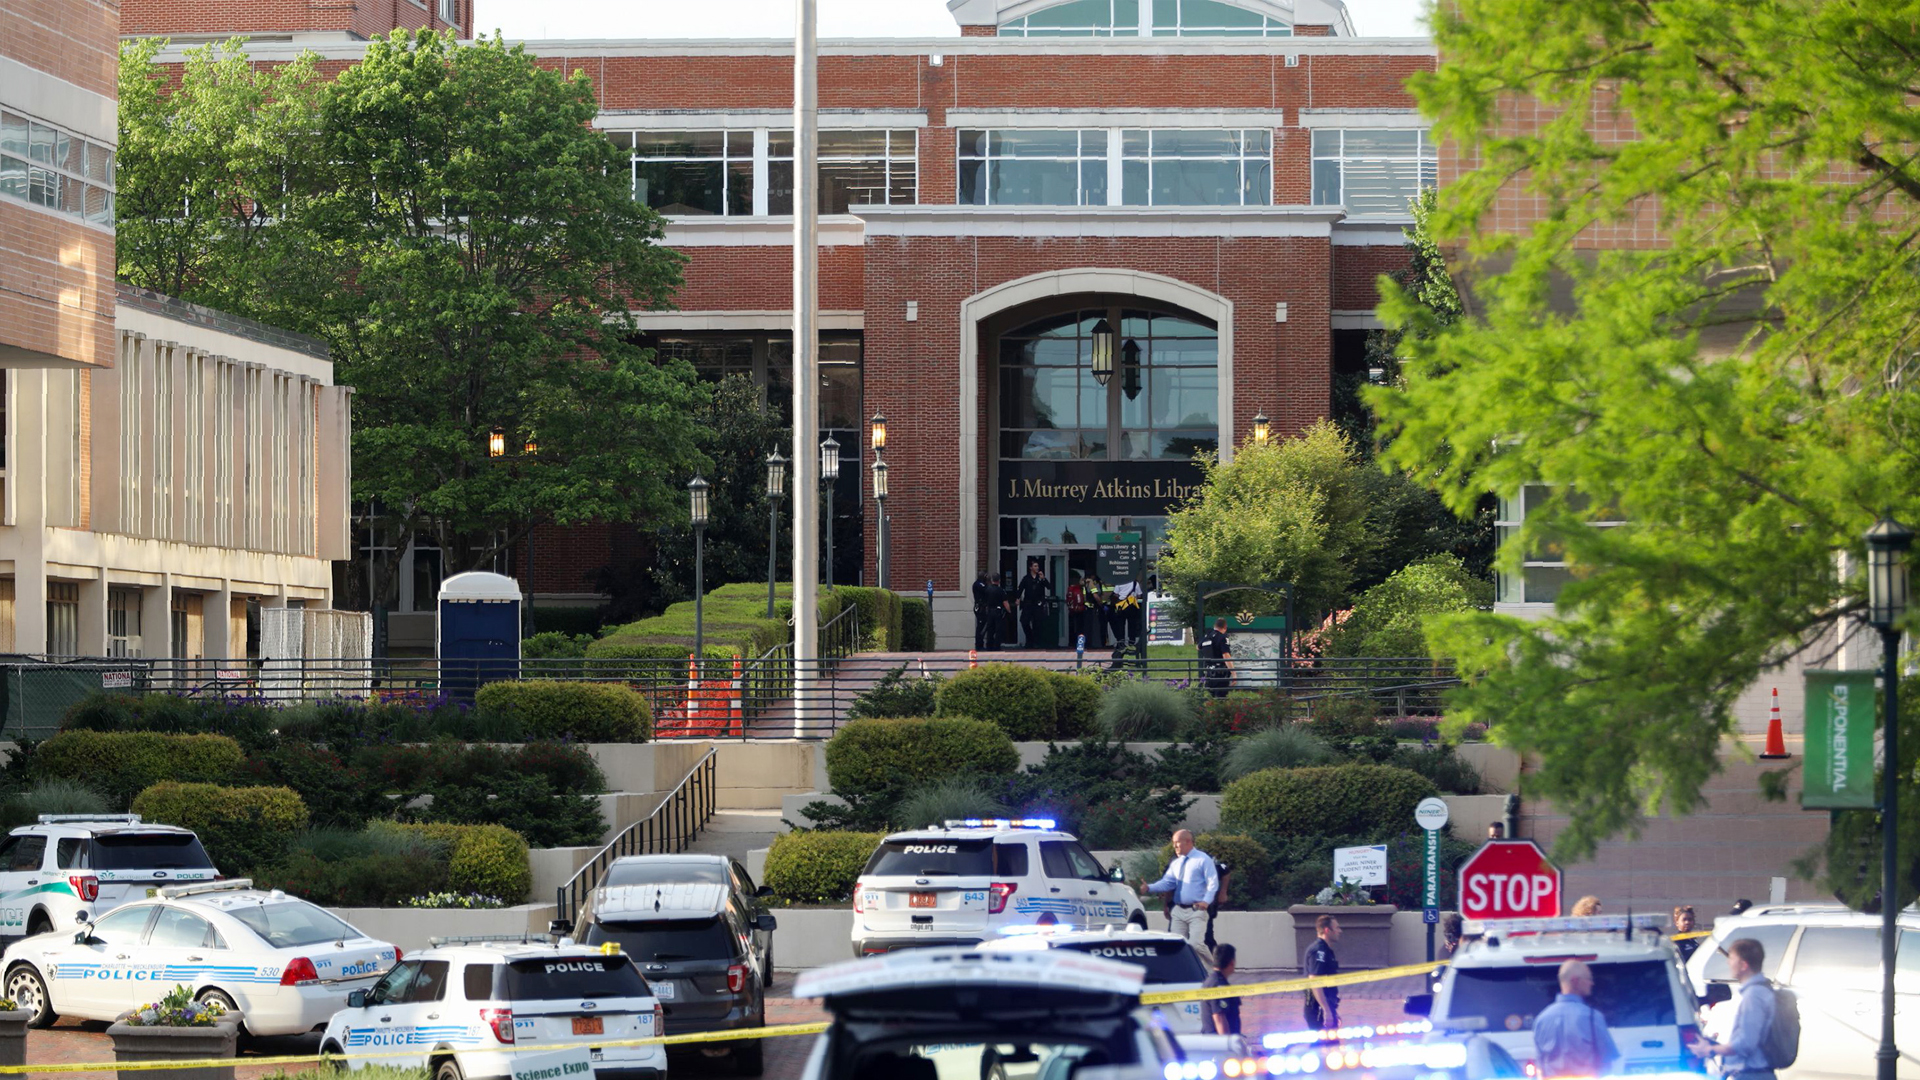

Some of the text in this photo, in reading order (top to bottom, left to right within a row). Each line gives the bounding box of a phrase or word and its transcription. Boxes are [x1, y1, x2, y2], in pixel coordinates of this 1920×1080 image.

[1009, 478, 1201, 502] J. Murrey Atkins Libra
[103, 672, 131, 680] NATIONA
[1833, 684, 1848, 793] EXPONENTIAL
[903, 845, 958, 854] POLICE
[1426, 830, 1437, 906] PARATRANSIT
[964, 892, 985, 901] 643
[1467, 874, 1553, 911] STOP
[1071, 905, 1112, 917] POLICE
[381, 951, 395, 960] 530
[1090, 947, 1158, 957] POLICE
[316, 961, 332, 969] 911
[342, 962, 378, 976] POLICE
[544, 962, 605, 974] POLICE
[83, 969, 164, 981] POLICE
[261, 967, 280, 977] 530
[637, 1015, 653, 1025] 187
[467, 1026, 481, 1037] 187
[364, 1033, 414, 1046] POLICE
[515, 1061, 589, 1080] Science Expo
